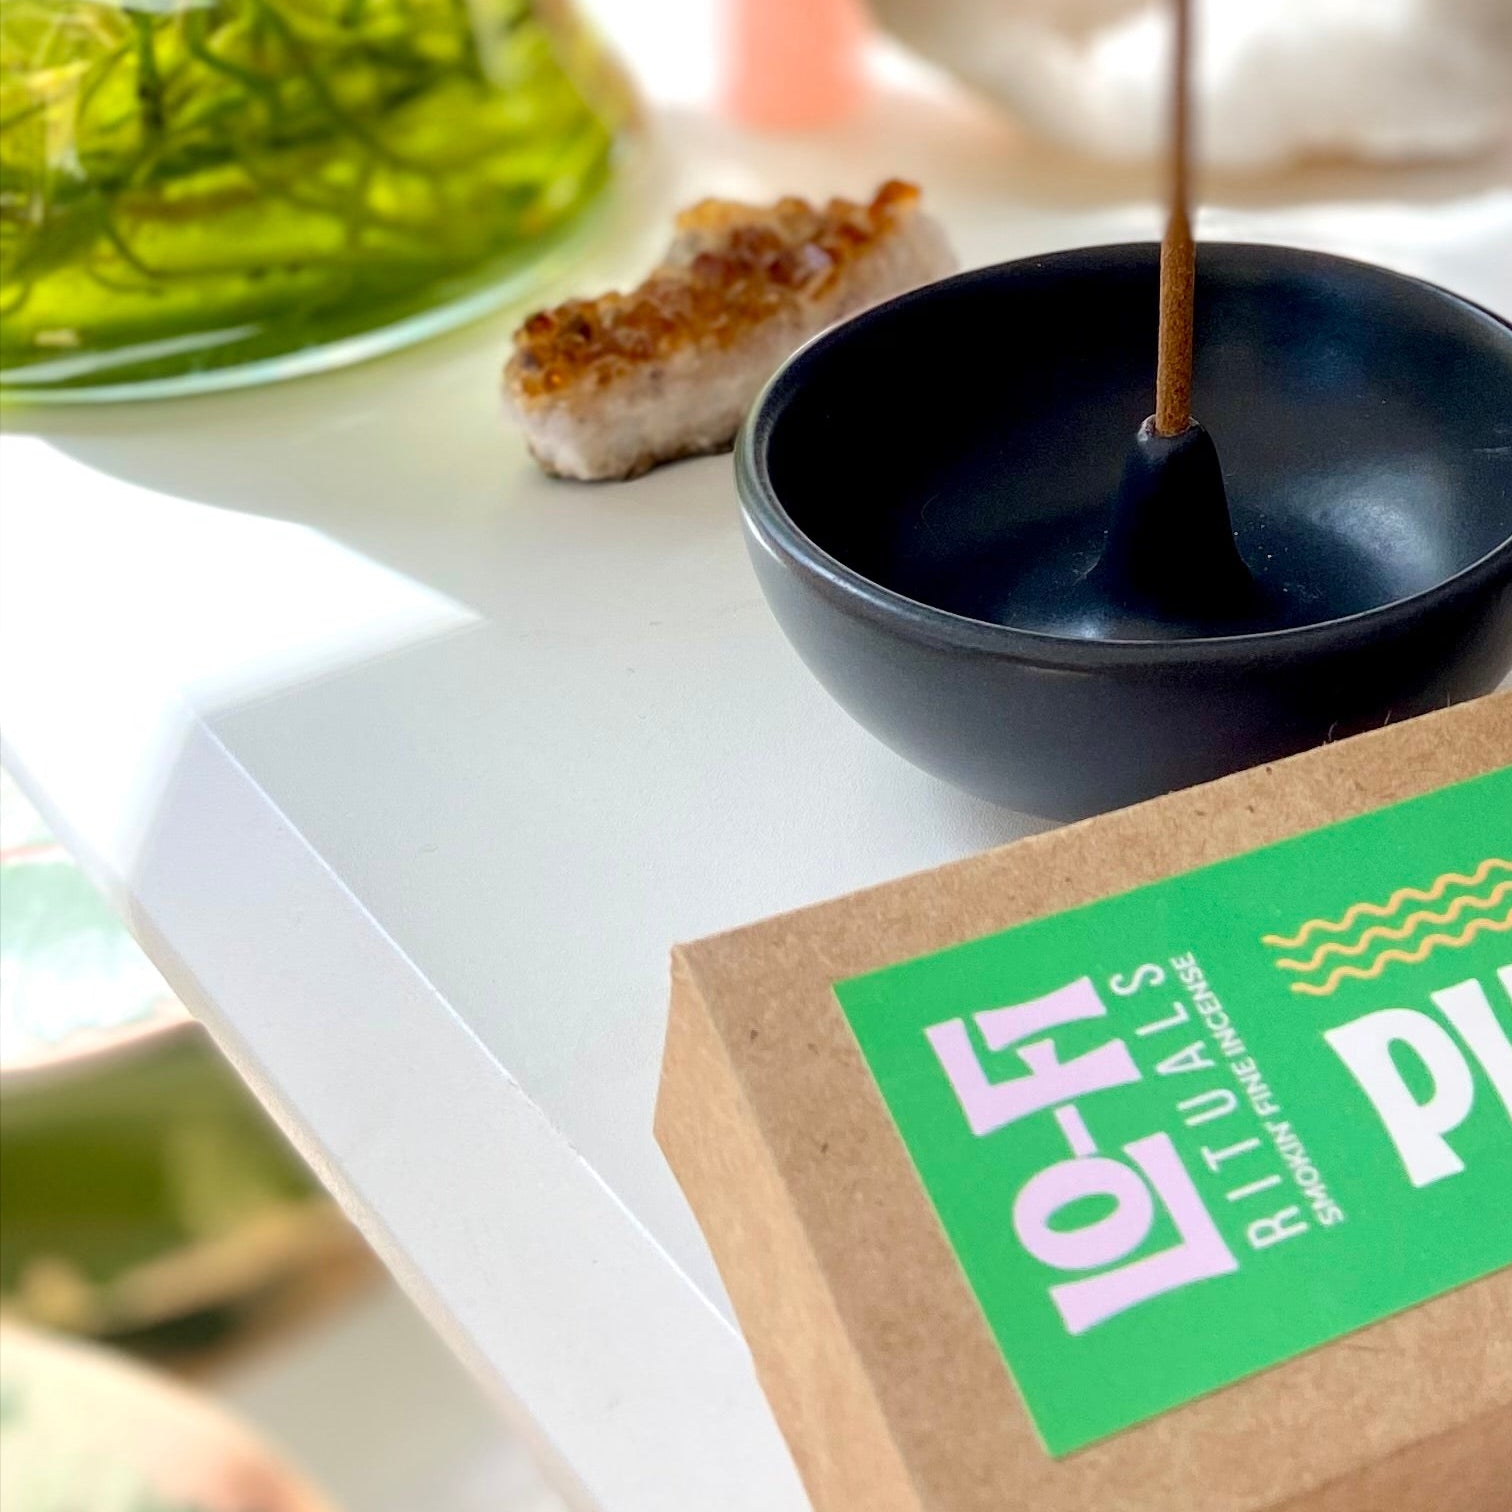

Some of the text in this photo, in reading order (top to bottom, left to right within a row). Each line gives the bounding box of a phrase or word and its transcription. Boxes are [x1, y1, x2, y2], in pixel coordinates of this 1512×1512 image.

[923, 975, 1240, 1337] LO-FI
[1108, 961, 1309, 1250] RITUALS
[1168, 950, 1345, 1227] SMOKIN' FINE INCENSE
